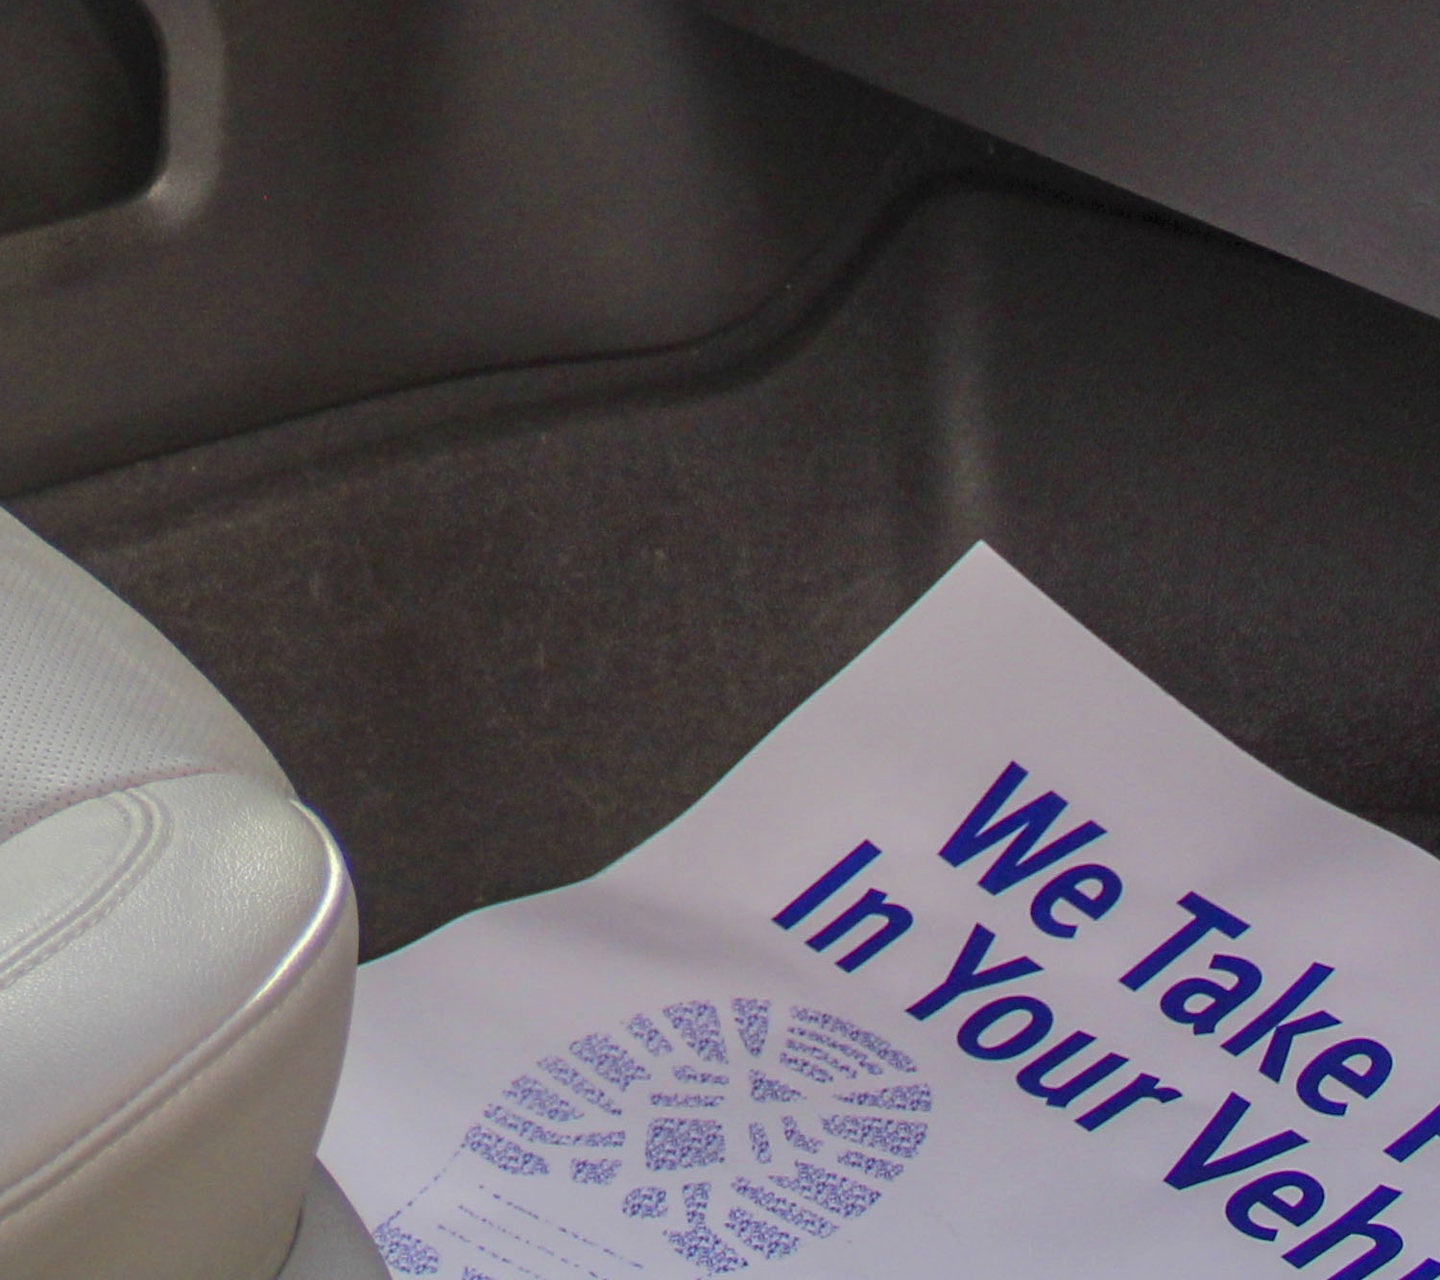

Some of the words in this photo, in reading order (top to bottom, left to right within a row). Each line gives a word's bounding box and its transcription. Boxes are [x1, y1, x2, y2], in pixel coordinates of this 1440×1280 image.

[773, 839, 913, 971] In
[908, 924, 1182, 1130] Your
[939, 762, 1122, 938] We
[1120, 892, 1392, 1115] Take
